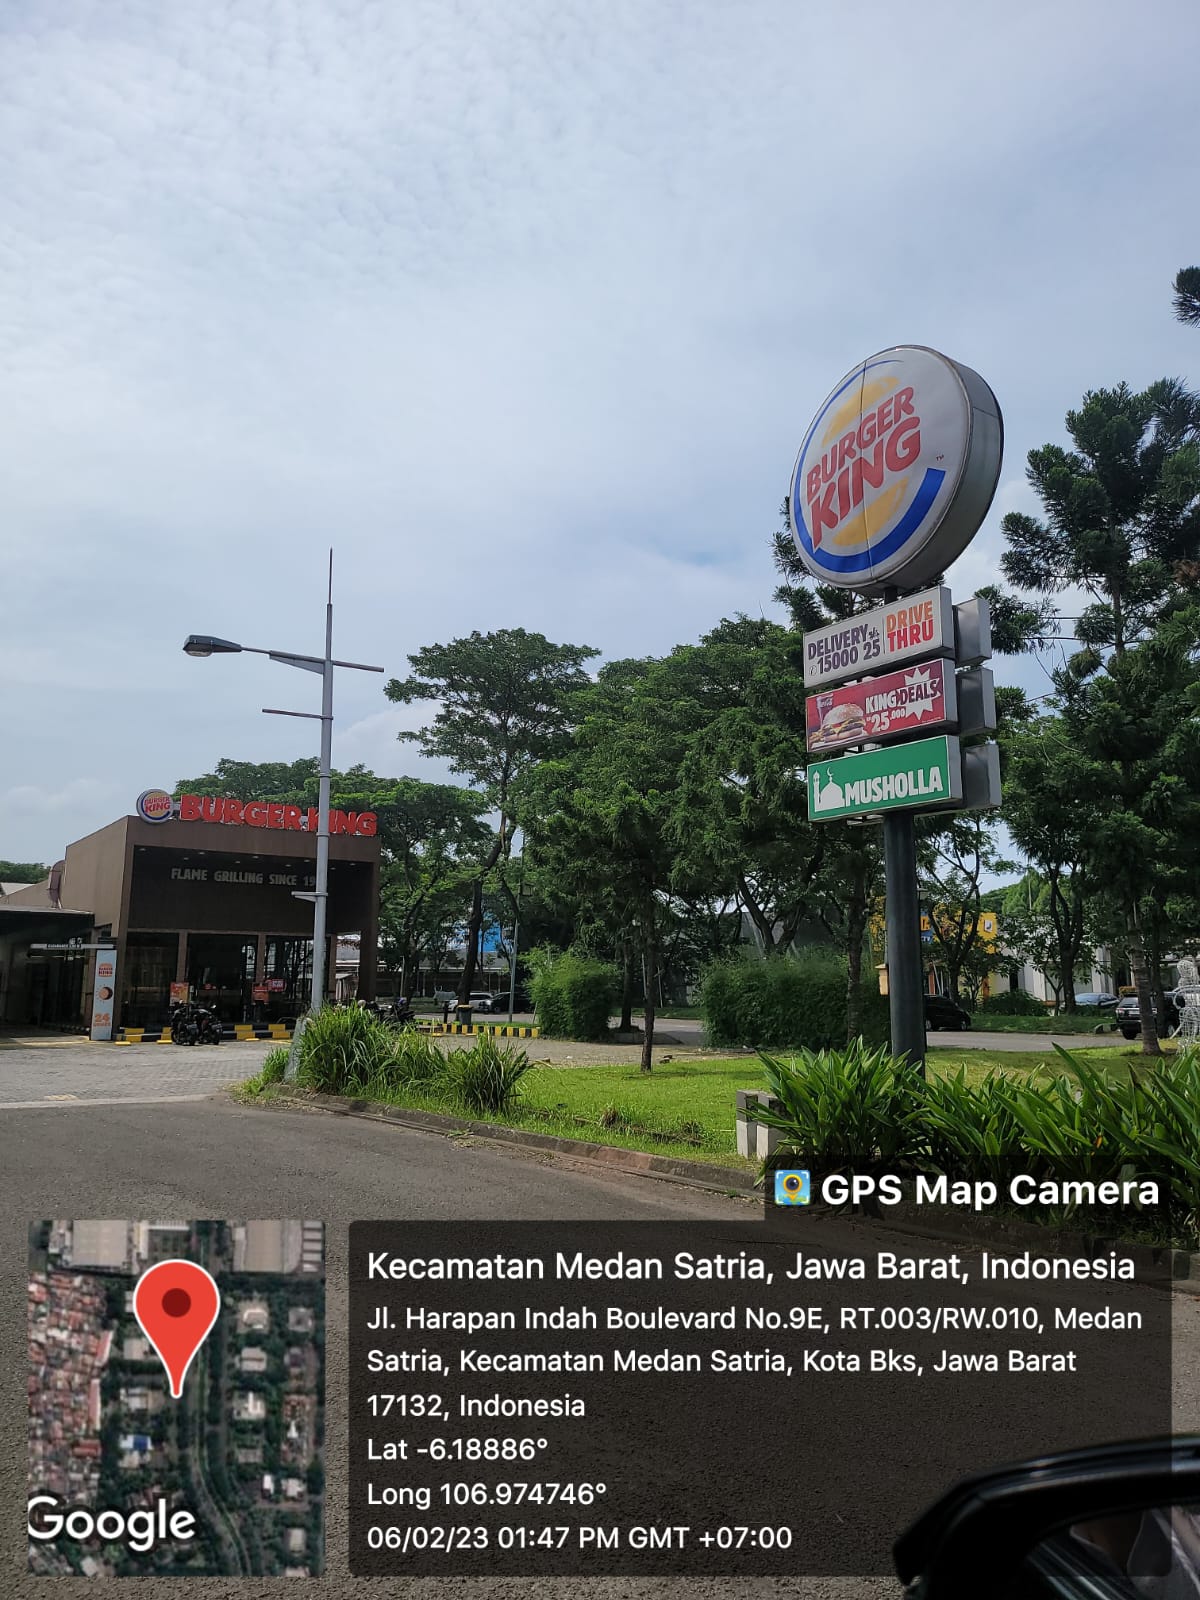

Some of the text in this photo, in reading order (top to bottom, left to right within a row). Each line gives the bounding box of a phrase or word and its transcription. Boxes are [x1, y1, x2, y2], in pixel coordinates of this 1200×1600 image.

[806, 386, 915, 507] BURGER
[811, 416, 921, 554] KING
[886, 600, 933, 633] DRIVE
[807, 624, 869, 660] DELIVERY
[887, 620, 934, 653] THRU
[817, 639, 881, 674] 15000 25
[865, 680, 938, 714] KING DEALS
[844, 766, 944, 807] MUSHOLLA
[145, 803, 171, 813] KING
[180, 794, 303, 831] BURGER
[171, 868, 317, 887] FLAME GRILLING SINCE 19
